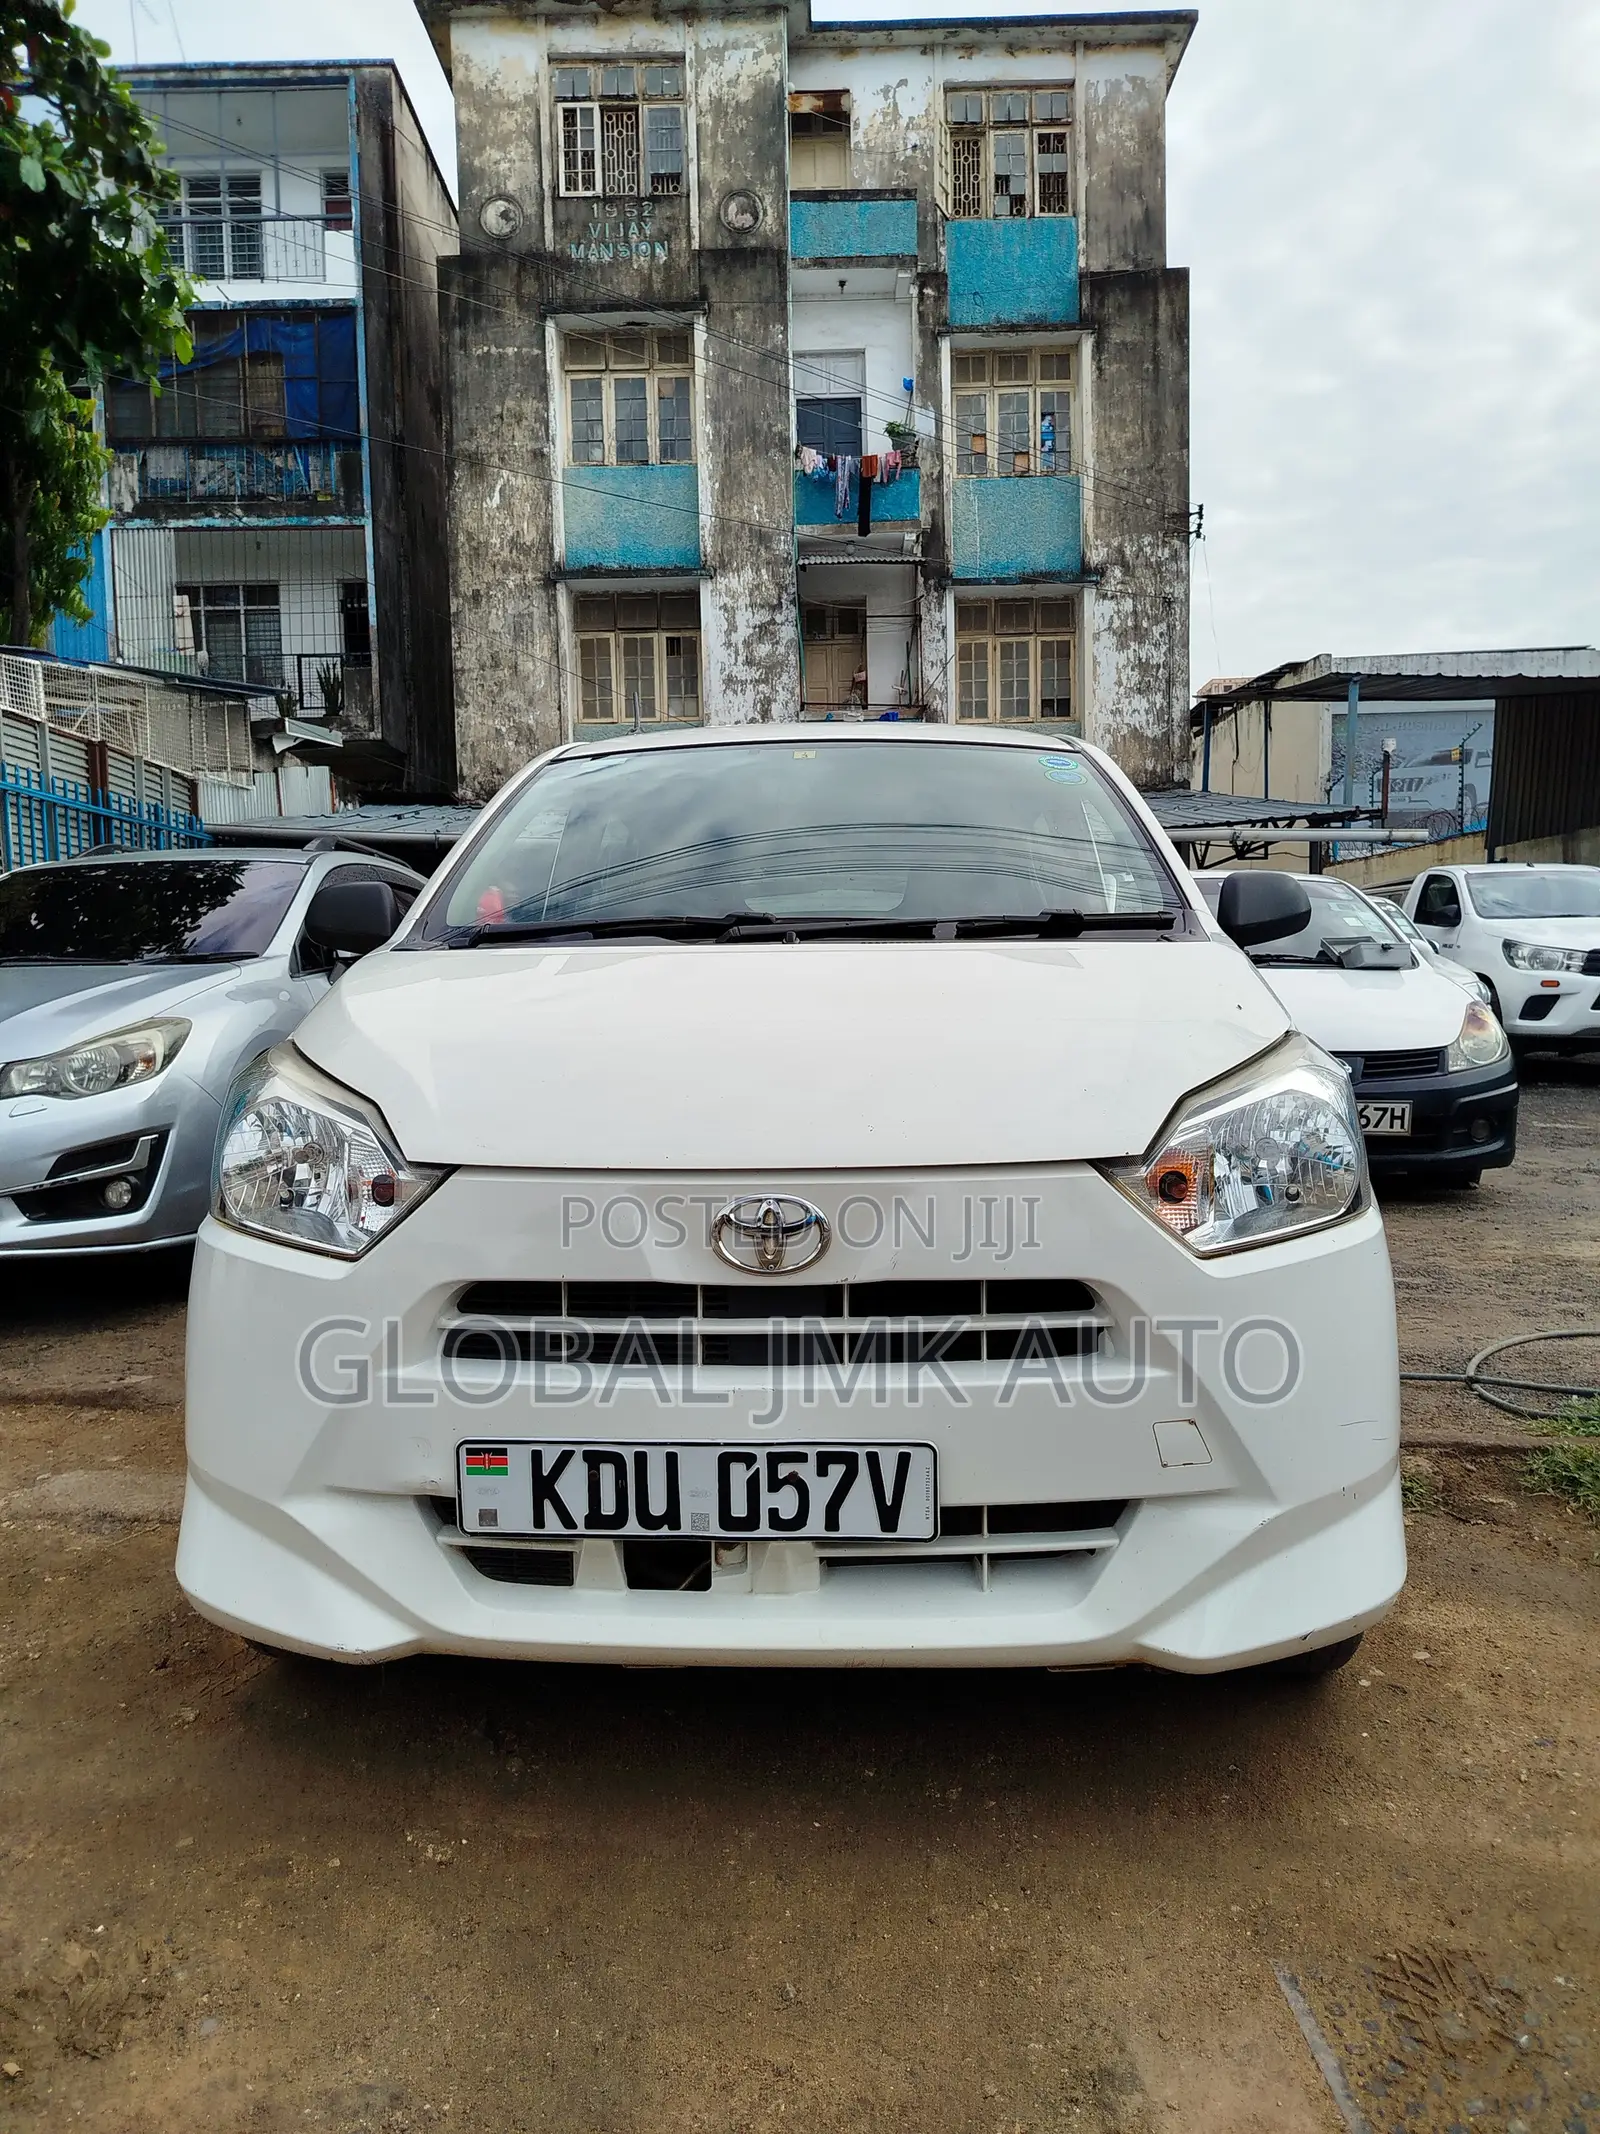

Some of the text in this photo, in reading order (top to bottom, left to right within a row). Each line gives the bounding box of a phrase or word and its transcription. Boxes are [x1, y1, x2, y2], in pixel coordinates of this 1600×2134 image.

[592, 201, 656, 218] 1952
[588, 222, 652, 239] VIJAY
[570, 241, 669, 260] MANSION
[530, 1448, 912, 1533] KDU 057V
